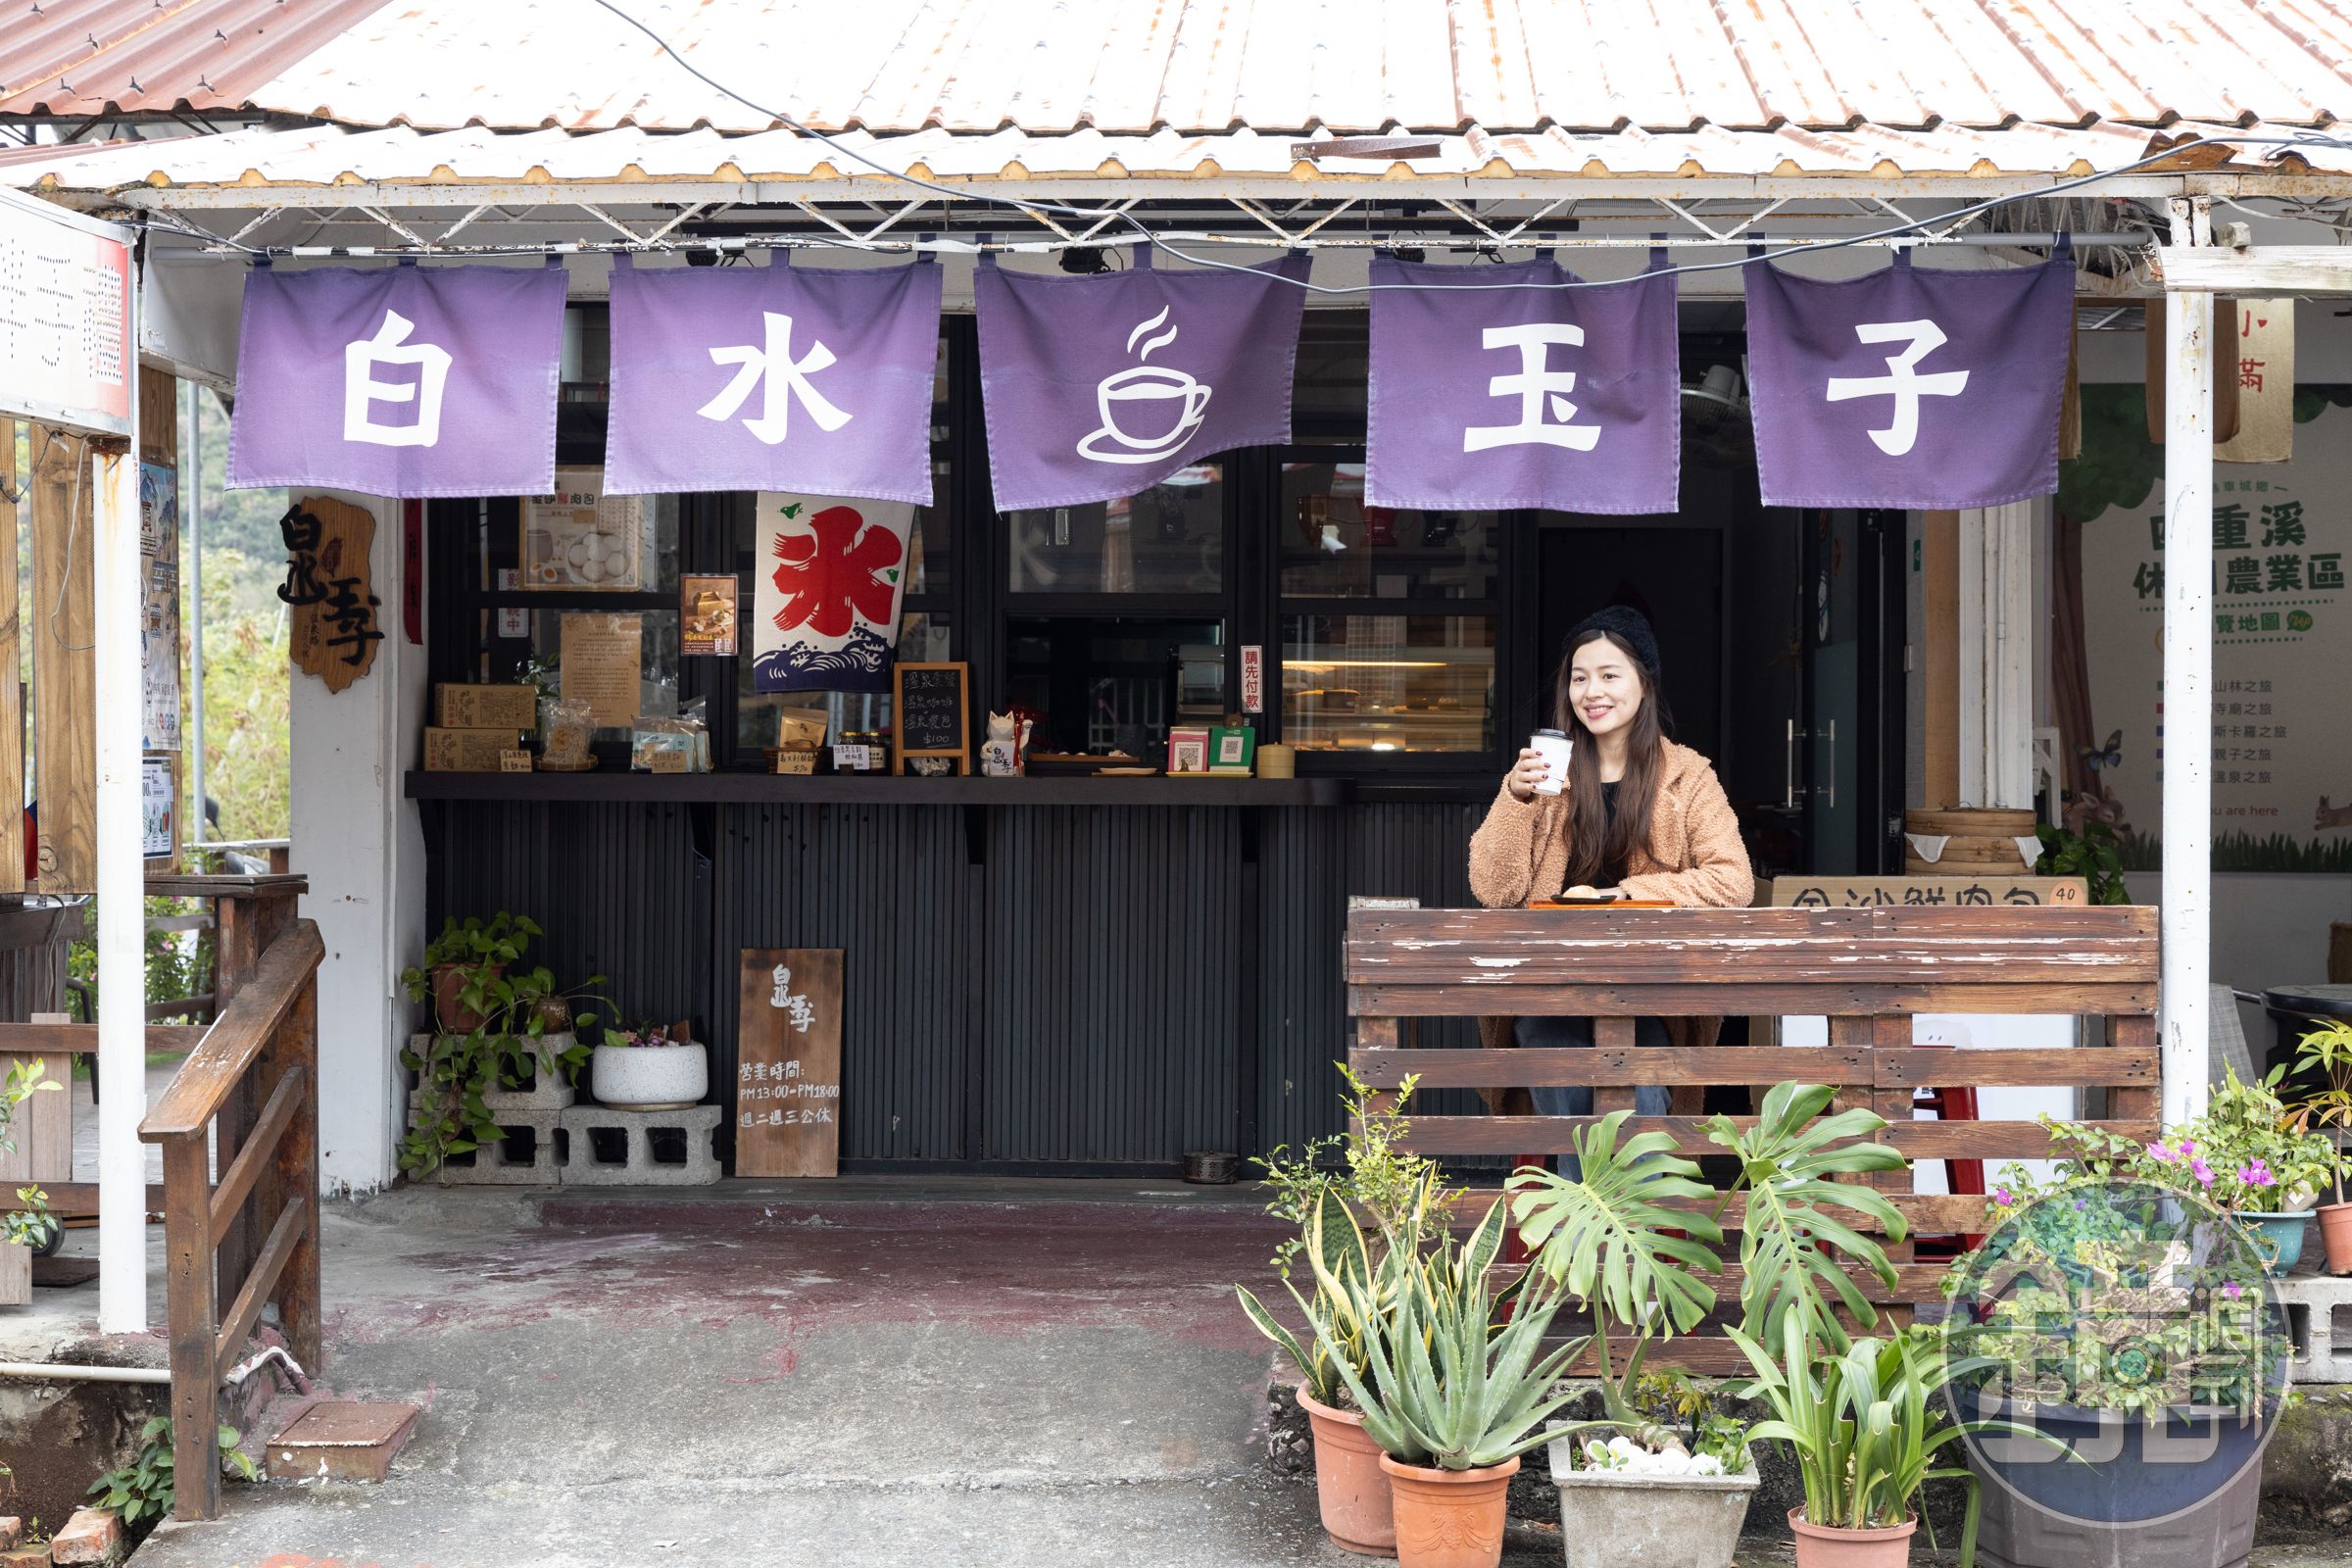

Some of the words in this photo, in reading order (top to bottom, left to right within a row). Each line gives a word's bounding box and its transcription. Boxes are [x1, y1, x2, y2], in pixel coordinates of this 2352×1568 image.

[343, 309, 452, 449] 白
[697, 310, 854, 446] 水
[1462, 323, 1601, 452] 玉
[1826, 318, 1971, 457] 子
[2213, 480, 2269, 492] 車城鄉
[2133, 552, 2344, 600] 休農業區
[2216, 612, 2280, 634] 覽地圖
[1245, 650, 1259, 709] 請先付款
[2215, 680, 2273, 693] 山林之旅
[2215, 703, 2272, 715] 寺廟之旅
[923, 732, 950, 744] $100
[2214, 725, 2287, 738] 斯卡羅之旅
[2214, 749, 2272, 761] 親子之旅
[2213, 771, 2272, 784] 溫泉之旅
[2250, 806, 2278, 815] here
[2055, 887, 2076, 901] 40
